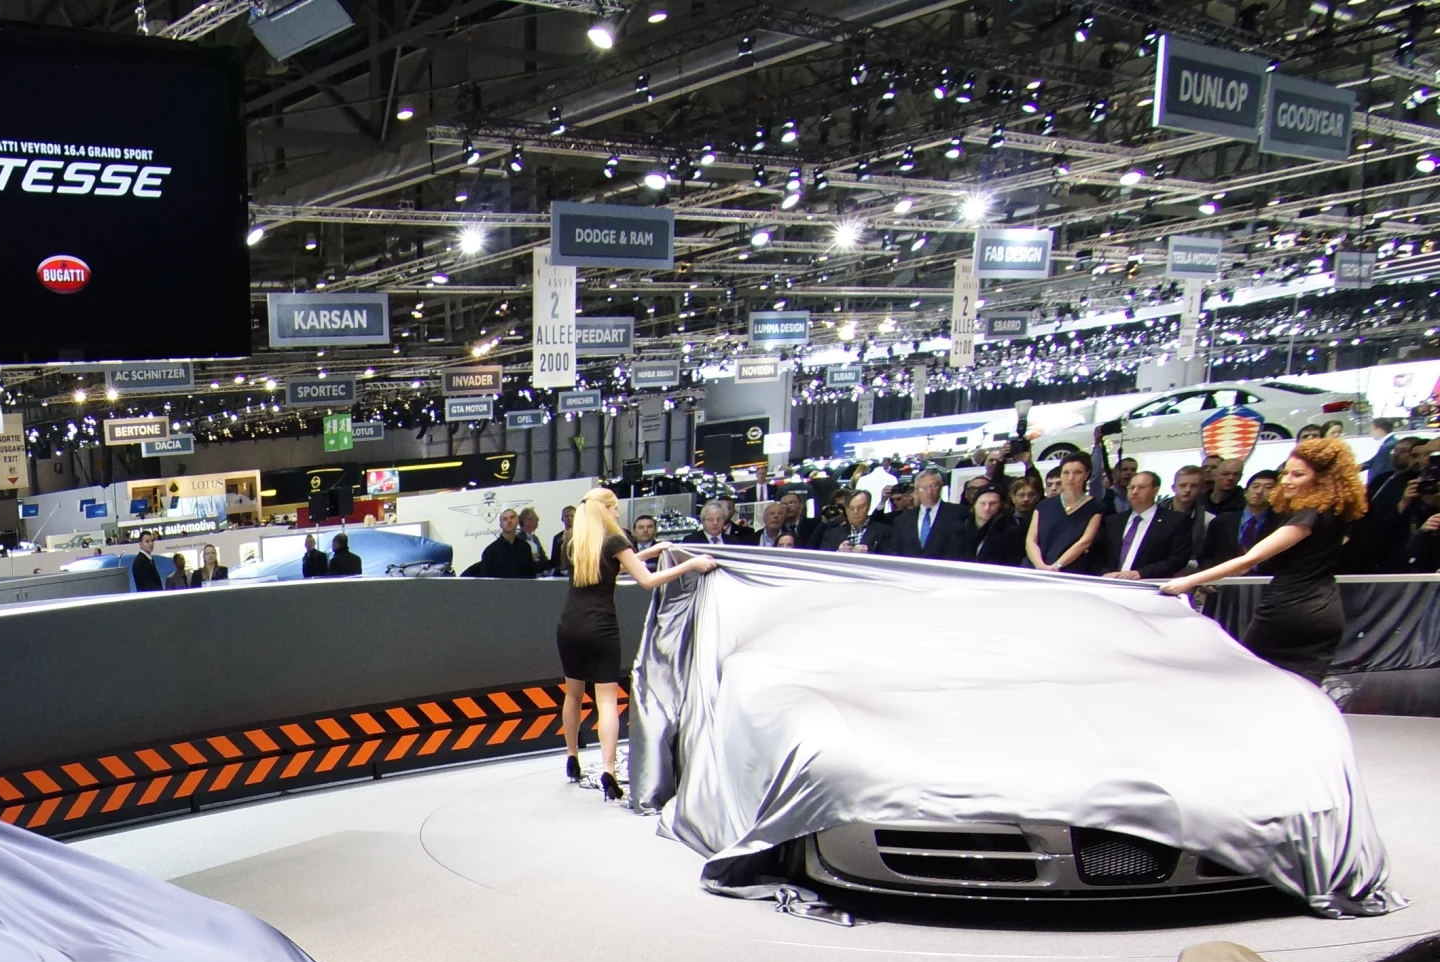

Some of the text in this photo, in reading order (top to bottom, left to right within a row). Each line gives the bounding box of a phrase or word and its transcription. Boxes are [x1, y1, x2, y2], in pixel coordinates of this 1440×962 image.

[1179, 70, 1249, 112] DUNLOP
[1277, 102, 1343, 138] GOODYEAR
[20, 141, 61, 155] VEYRON
[63, 144, 86, 157] 16.4
[88, 146, 121, 159] GRAND
[123, 148, 153, 161] SPORT
[575, 228, 654, 246] DODGE & RAM
[984, 246, 1043, 262] FAB DESIGN
[1173, 251, 1192, 264] TESLA
[43, 269, 85, 282] BUGATTI
[551, 291, 560, 318] 2
[962, 296, 969, 316] 2
[293, 309, 368, 331] KARSAN
[954, 319, 976, 334] ALLEE
[993, 320, 1021, 332] SBARRO
[754, 323, 805, 334] LUMMA DESIGN
[536, 325, 573, 346] ALLEE
[576, 328, 626, 343] PEEDART
[955, 340, 972, 355] 2100
[540, 352, 569, 372] 2000
[115, 368, 185, 381] AC SCHNITZER
[742, 365, 775, 376] NOVIDEM
[834, 372, 856, 381] SUBARU
[452, 375, 493, 387] INVADER
[297, 384, 346, 398] SPORTEC
[451, 404, 488, 414] GTA MOTOR
[517, 415, 533, 423] OPEL
[115, 424, 161, 437] BERTONE
[352, 427, 374, 436] LOTUS
[155, 440, 181, 450] DACIA
[1113, 435, 1162, 444] PORT
[191, 479, 224, 490] LOTUS
[165, 519, 216, 535] automotive
